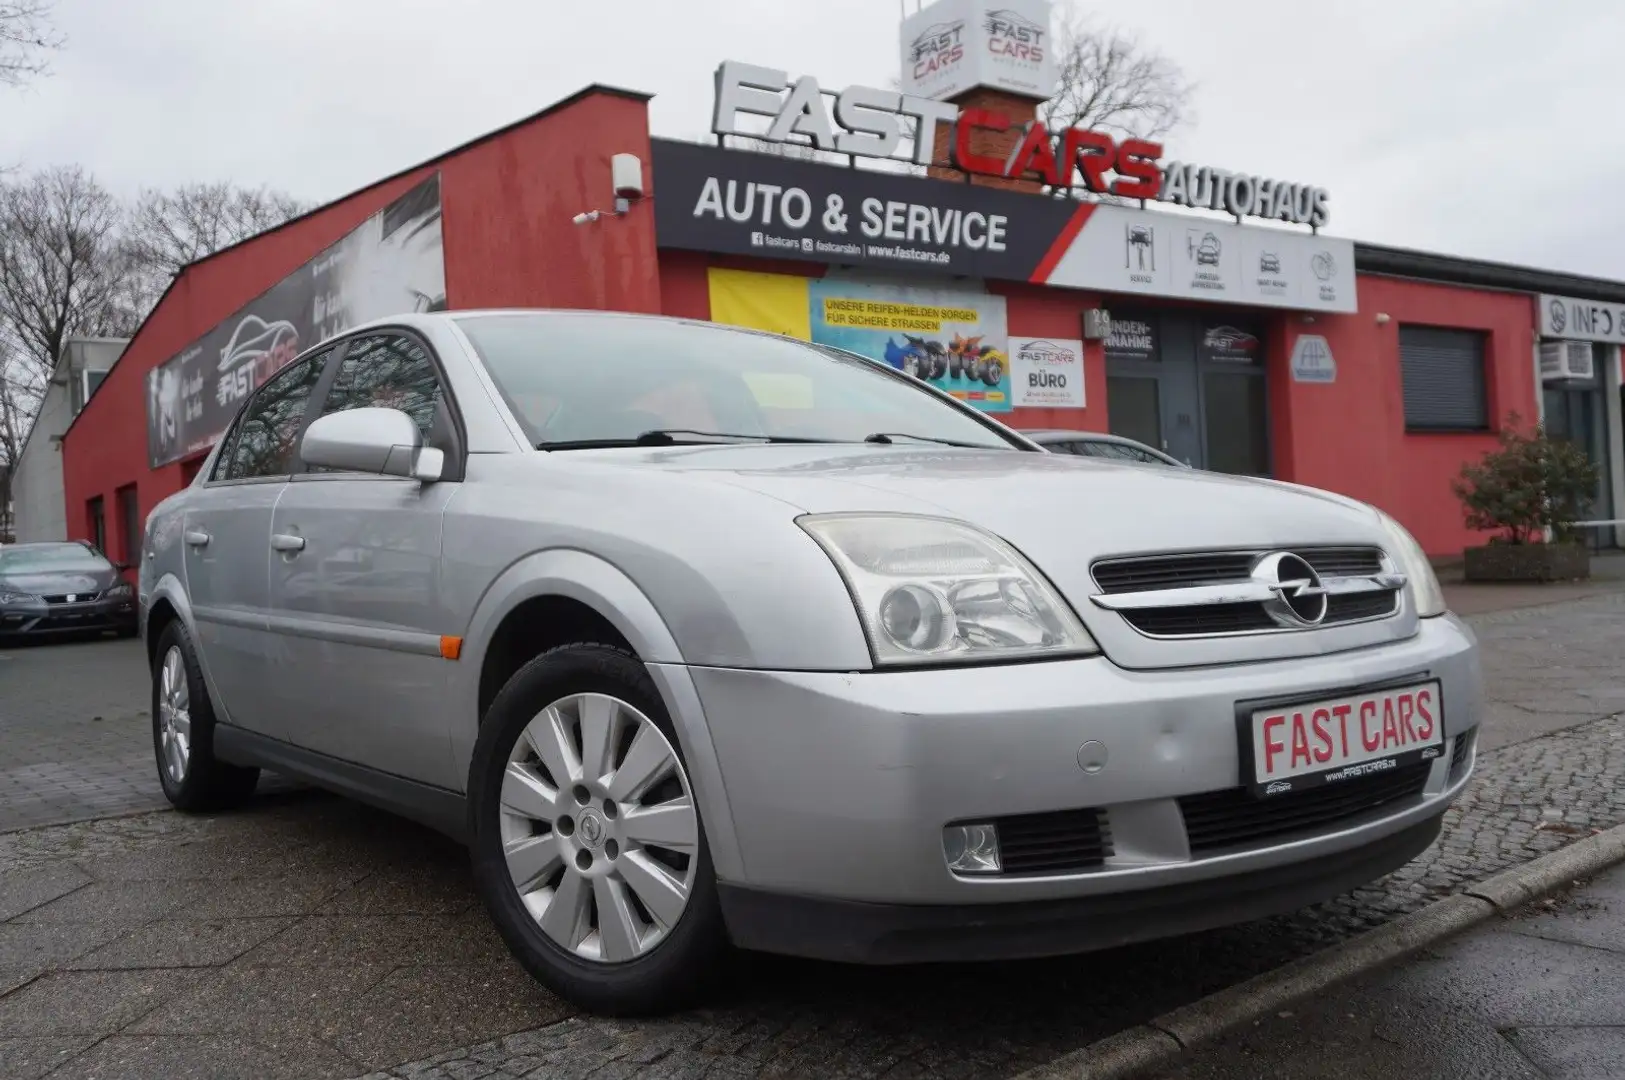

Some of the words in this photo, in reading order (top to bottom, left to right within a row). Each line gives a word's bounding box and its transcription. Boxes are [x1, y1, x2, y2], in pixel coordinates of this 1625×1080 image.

[914, 25, 964, 60] FAST
[989, 20, 1044, 45] FAST
[914, 44, 963, 79] CARS
[989, 37, 1043, 62] CARS
[1163, 160, 1329, 227] AUTOHAUS
[693, 176, 812, 228] AUTO
[822, 193, 848, 233] &
[860, 197, 1008, 250] SERVICE
[765, 234, 800, 248] fastcars
[868, 244, 951, 263] www.fastcars.de
[826, 300, 865, 313] UNSERE
[867, 303, 940, 319] REIFEN-HELDEN
[941, 309, 977, 321] SORGEN
[826, 312, 846, 324] FÜR
[848, 315, 889, 327] SICHERE
[1092, 308, 1110, 323] 26
[1029, 368, 1067, 388] BÜRO
[1263, 705, 1352, 774] FAST
[1360, 690, 1434, 752] CARS
